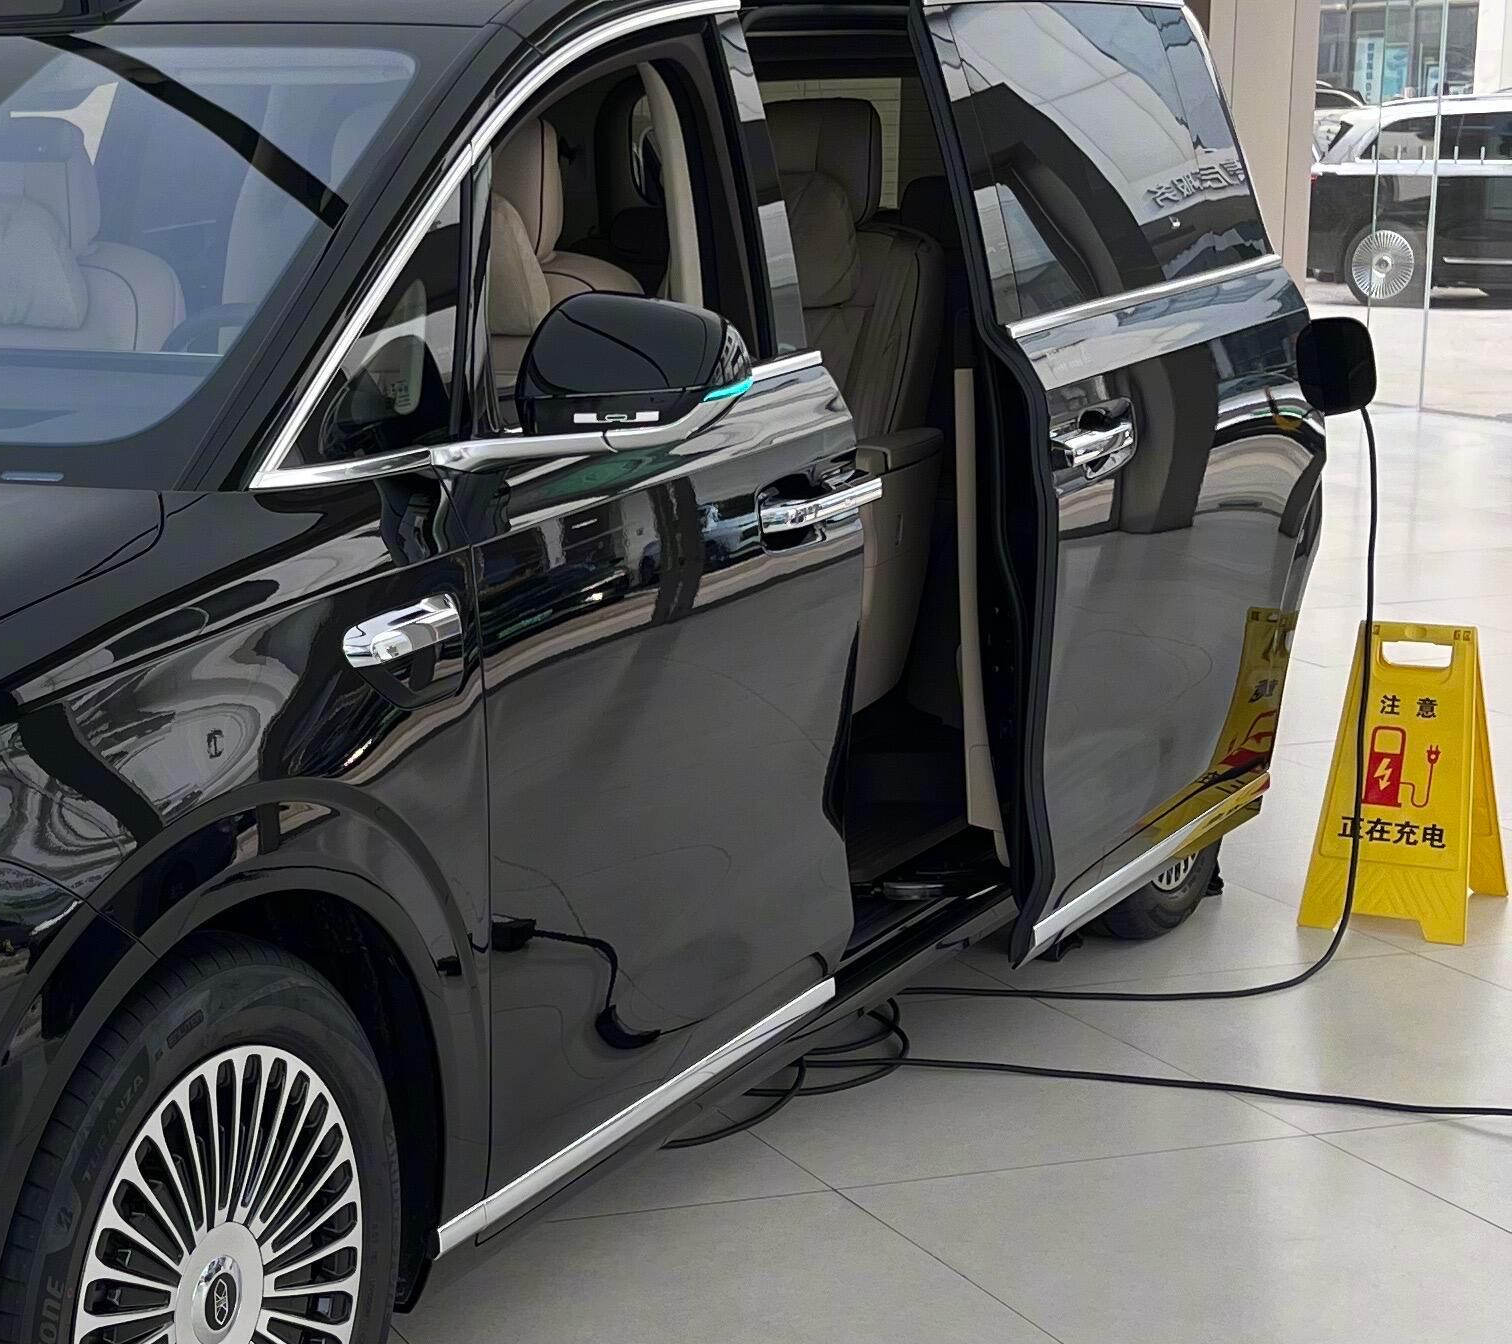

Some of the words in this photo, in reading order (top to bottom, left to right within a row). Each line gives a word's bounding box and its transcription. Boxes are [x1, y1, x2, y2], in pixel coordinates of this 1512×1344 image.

[1380, 694, 1438, 718] 注意
[1338, 815, 1447, 849] 正在充电
